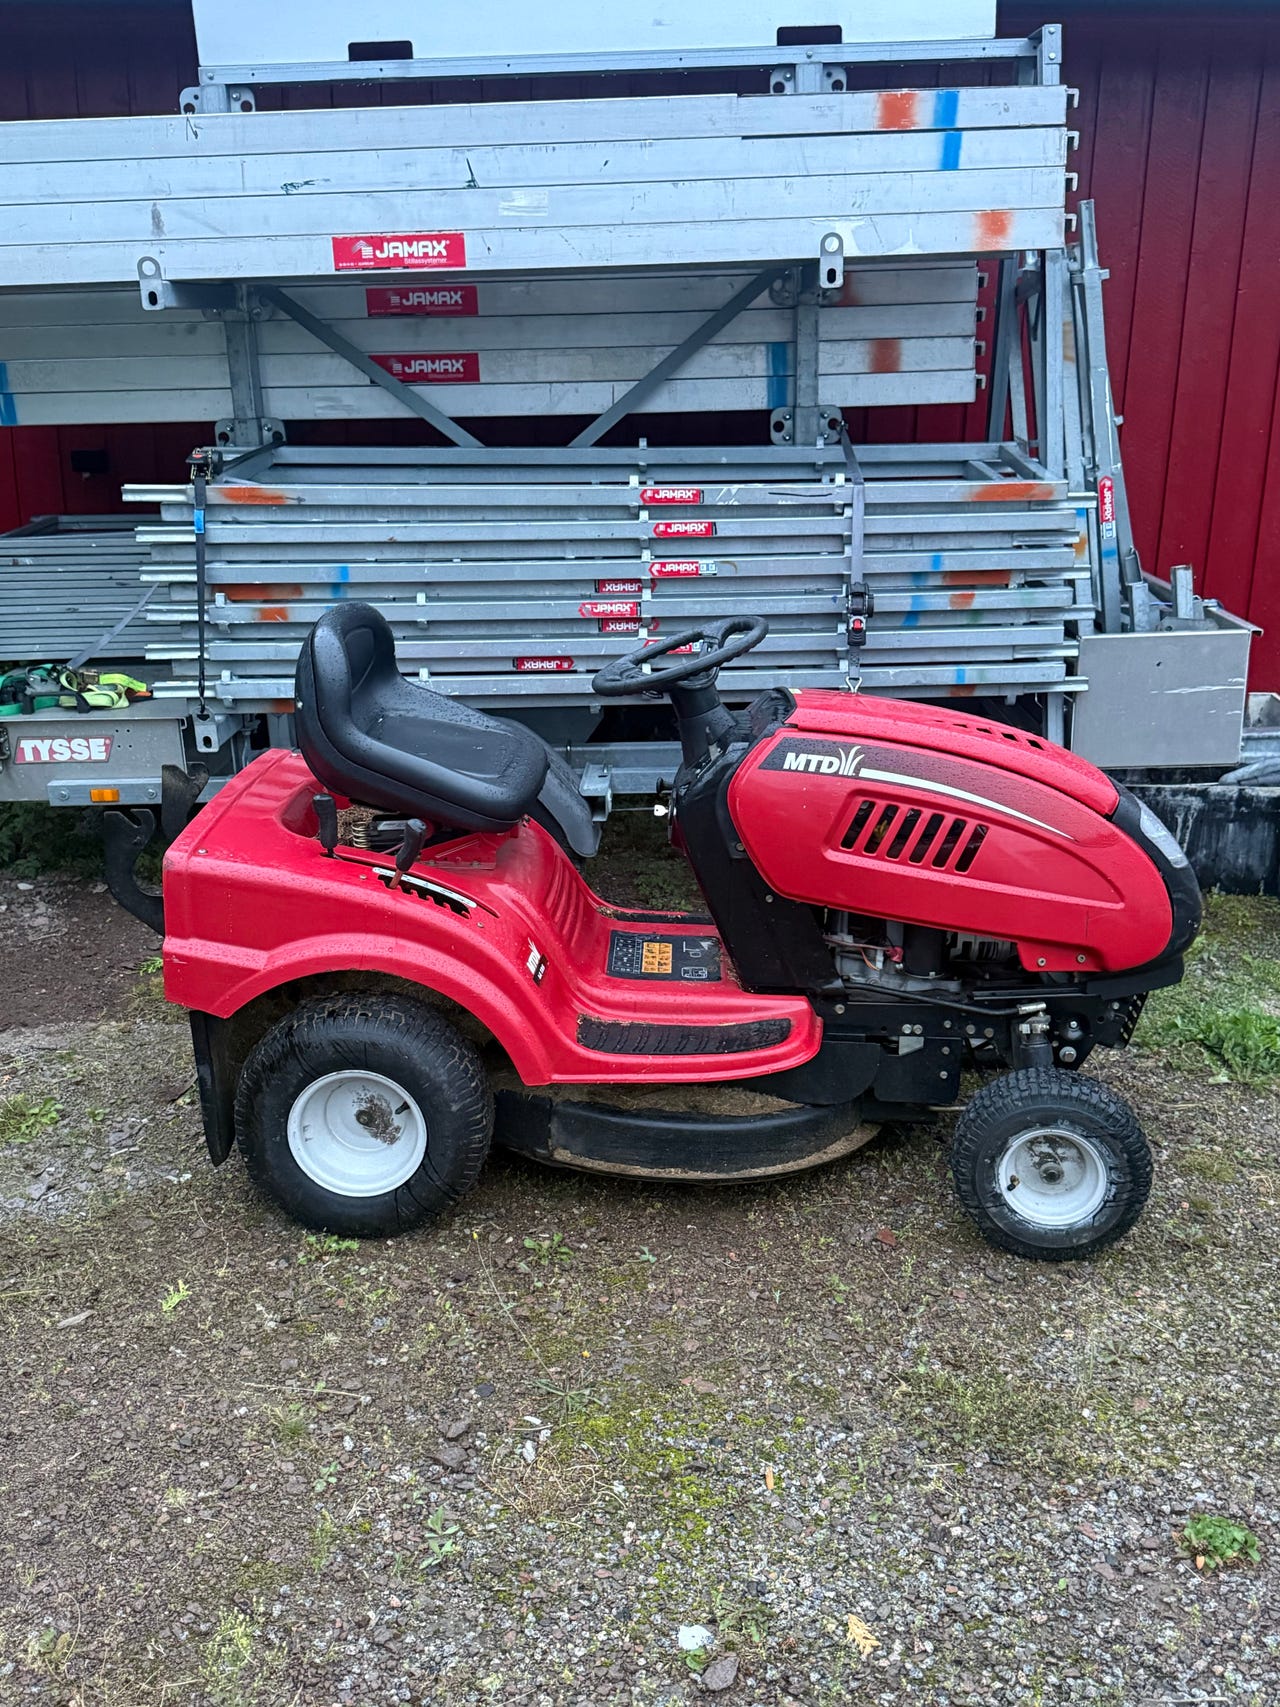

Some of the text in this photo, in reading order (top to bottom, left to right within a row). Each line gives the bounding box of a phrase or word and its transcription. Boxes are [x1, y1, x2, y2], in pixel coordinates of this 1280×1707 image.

[375, 240, 447, 258] JAMAX
[402, 291, 462, 305] JAMAX
[404, 359, 464, 374] JAMAX
[654, 489, 693, 499] JAMAX
[1103, 488, 1112, 521] JAMAX
[667, 523, 706, 533] JAMAX
[662, 563, 696, 572] JAMAX
[608, 622, 640, 630] AMAX
[524, 660, 561, 669] JAMAX
[20, 738, 107, 761] TYSSE
[783, 752, 840, 774] MTD
